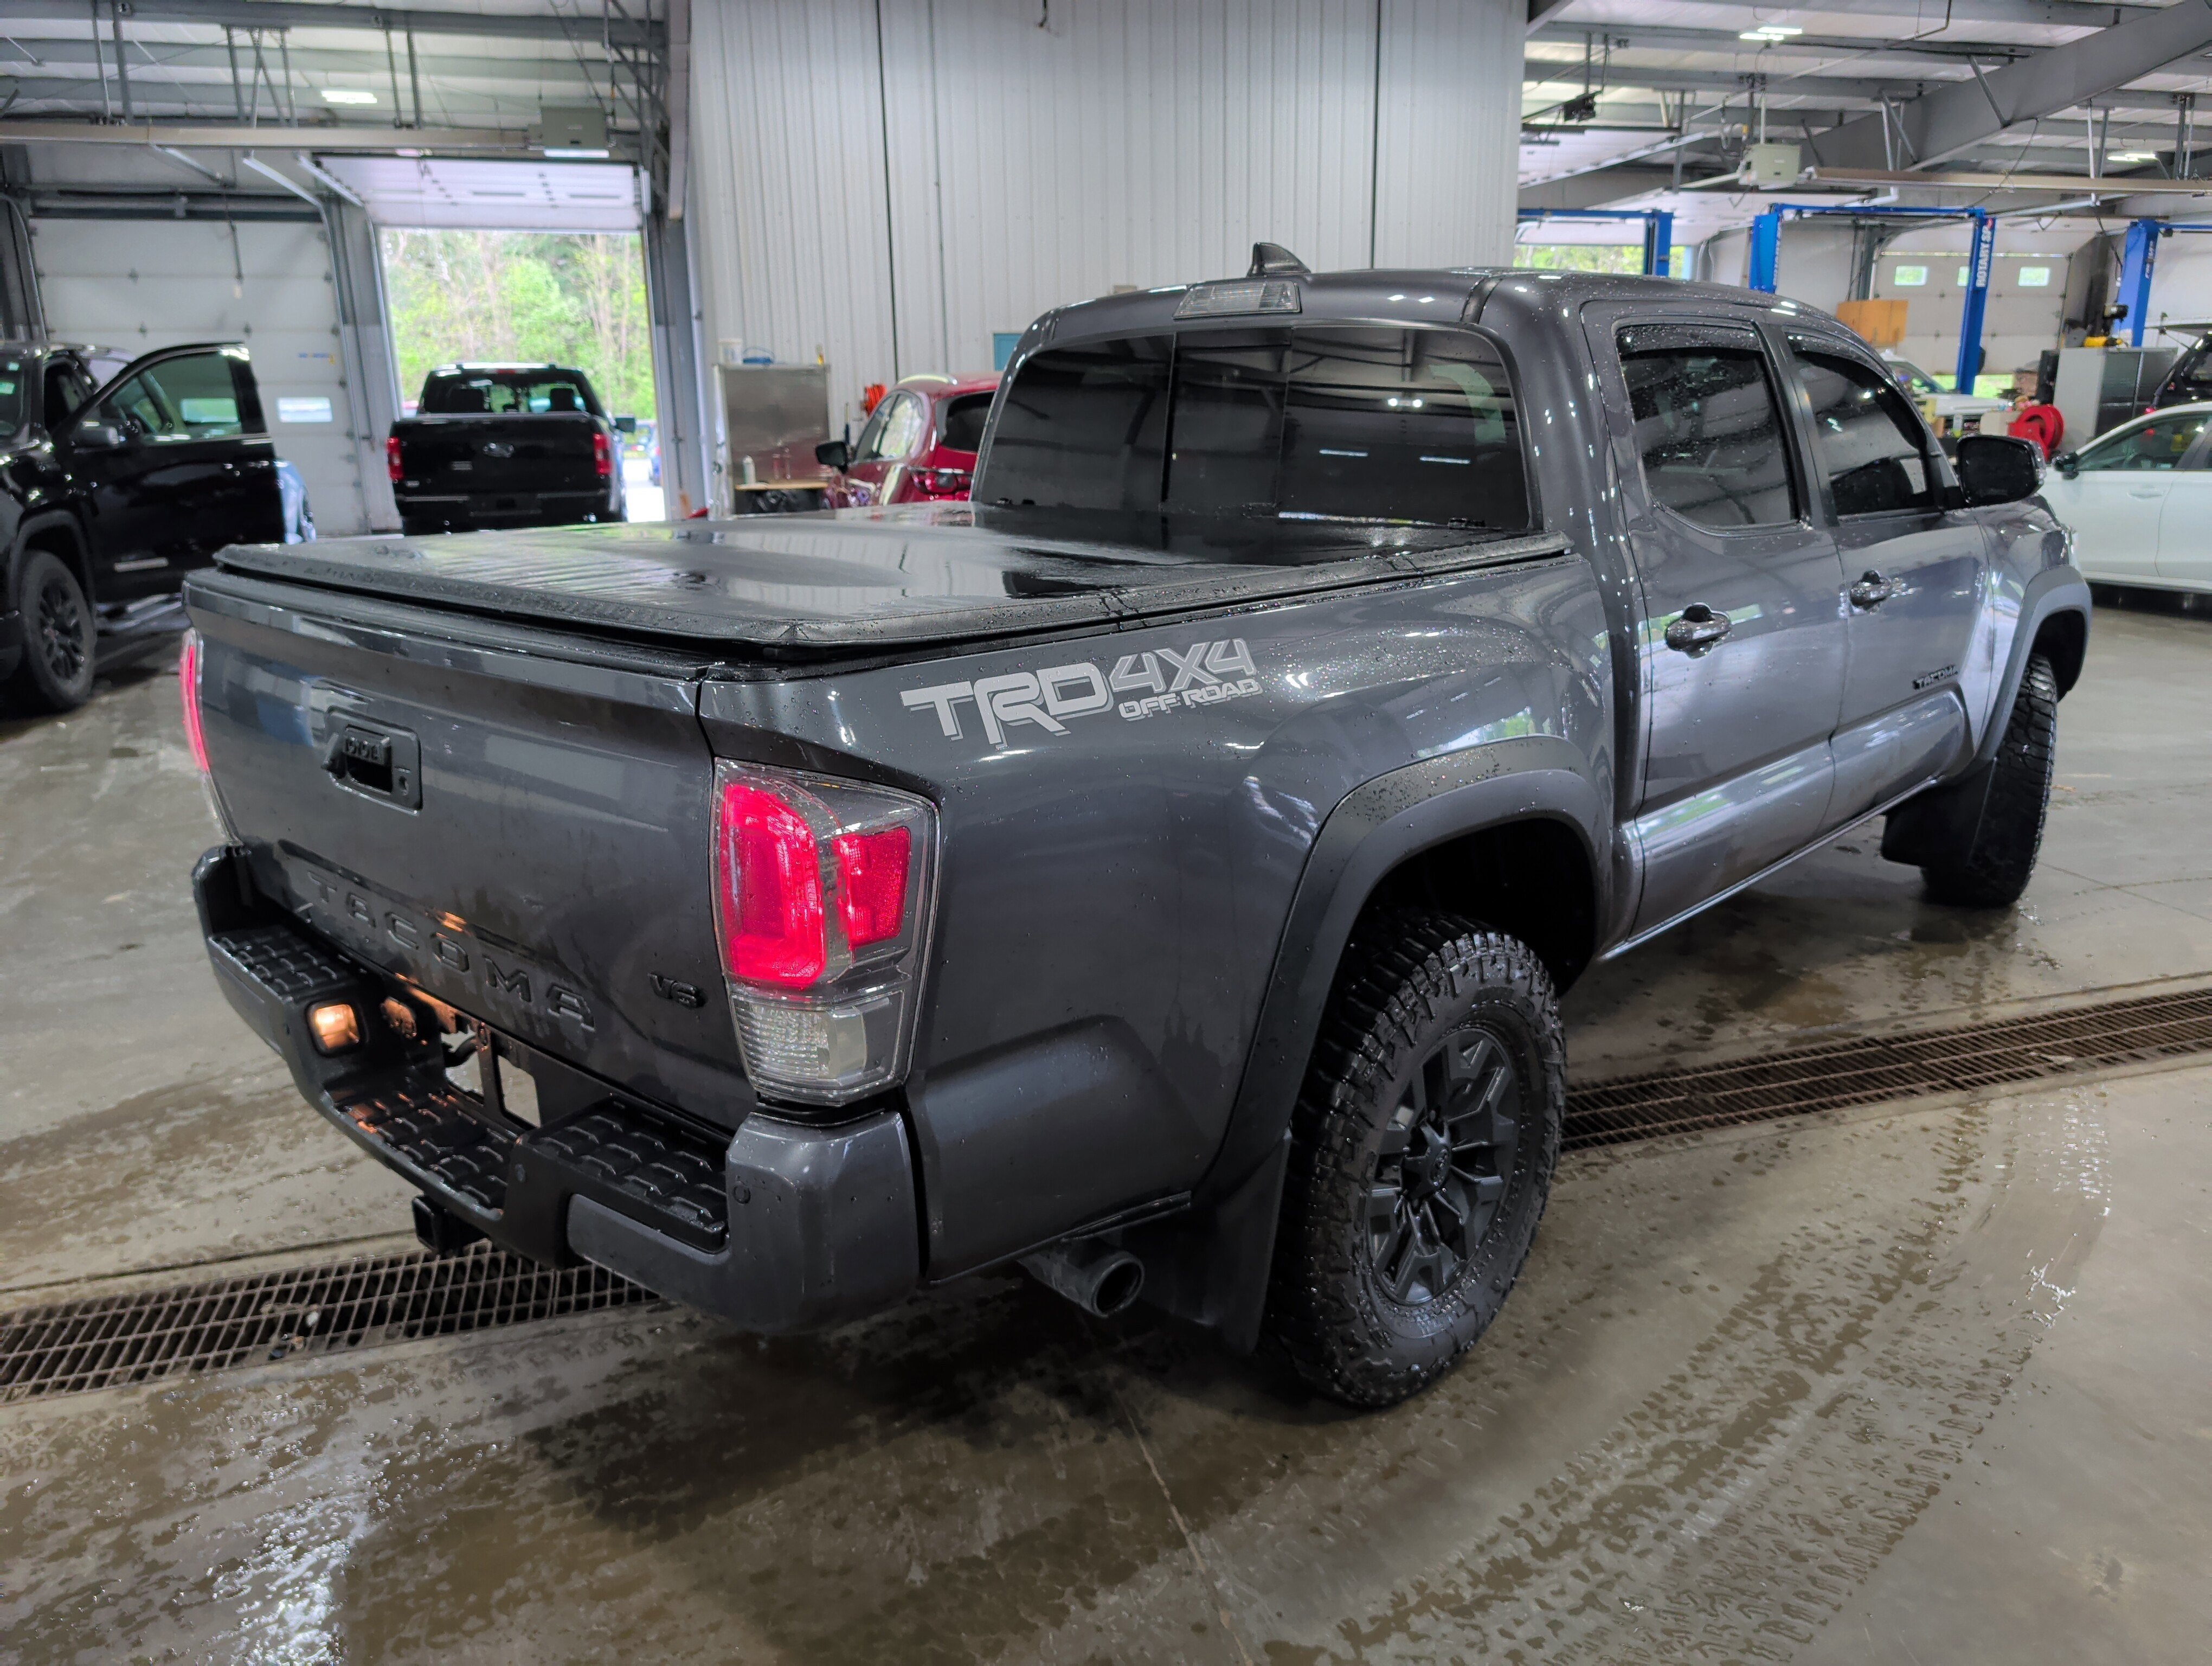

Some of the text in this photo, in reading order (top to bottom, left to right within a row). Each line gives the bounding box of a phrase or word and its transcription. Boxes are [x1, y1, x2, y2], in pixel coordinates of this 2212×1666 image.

[1976, 243, 1989, 287] ROTARY
[900, 637, 1258, 749] TRD 4X4
[1118, 678, 1264, 721] OFF ROAD
[307, 869, 597, 1033] TACOMA
[647, 971, 706, 1009] V6
